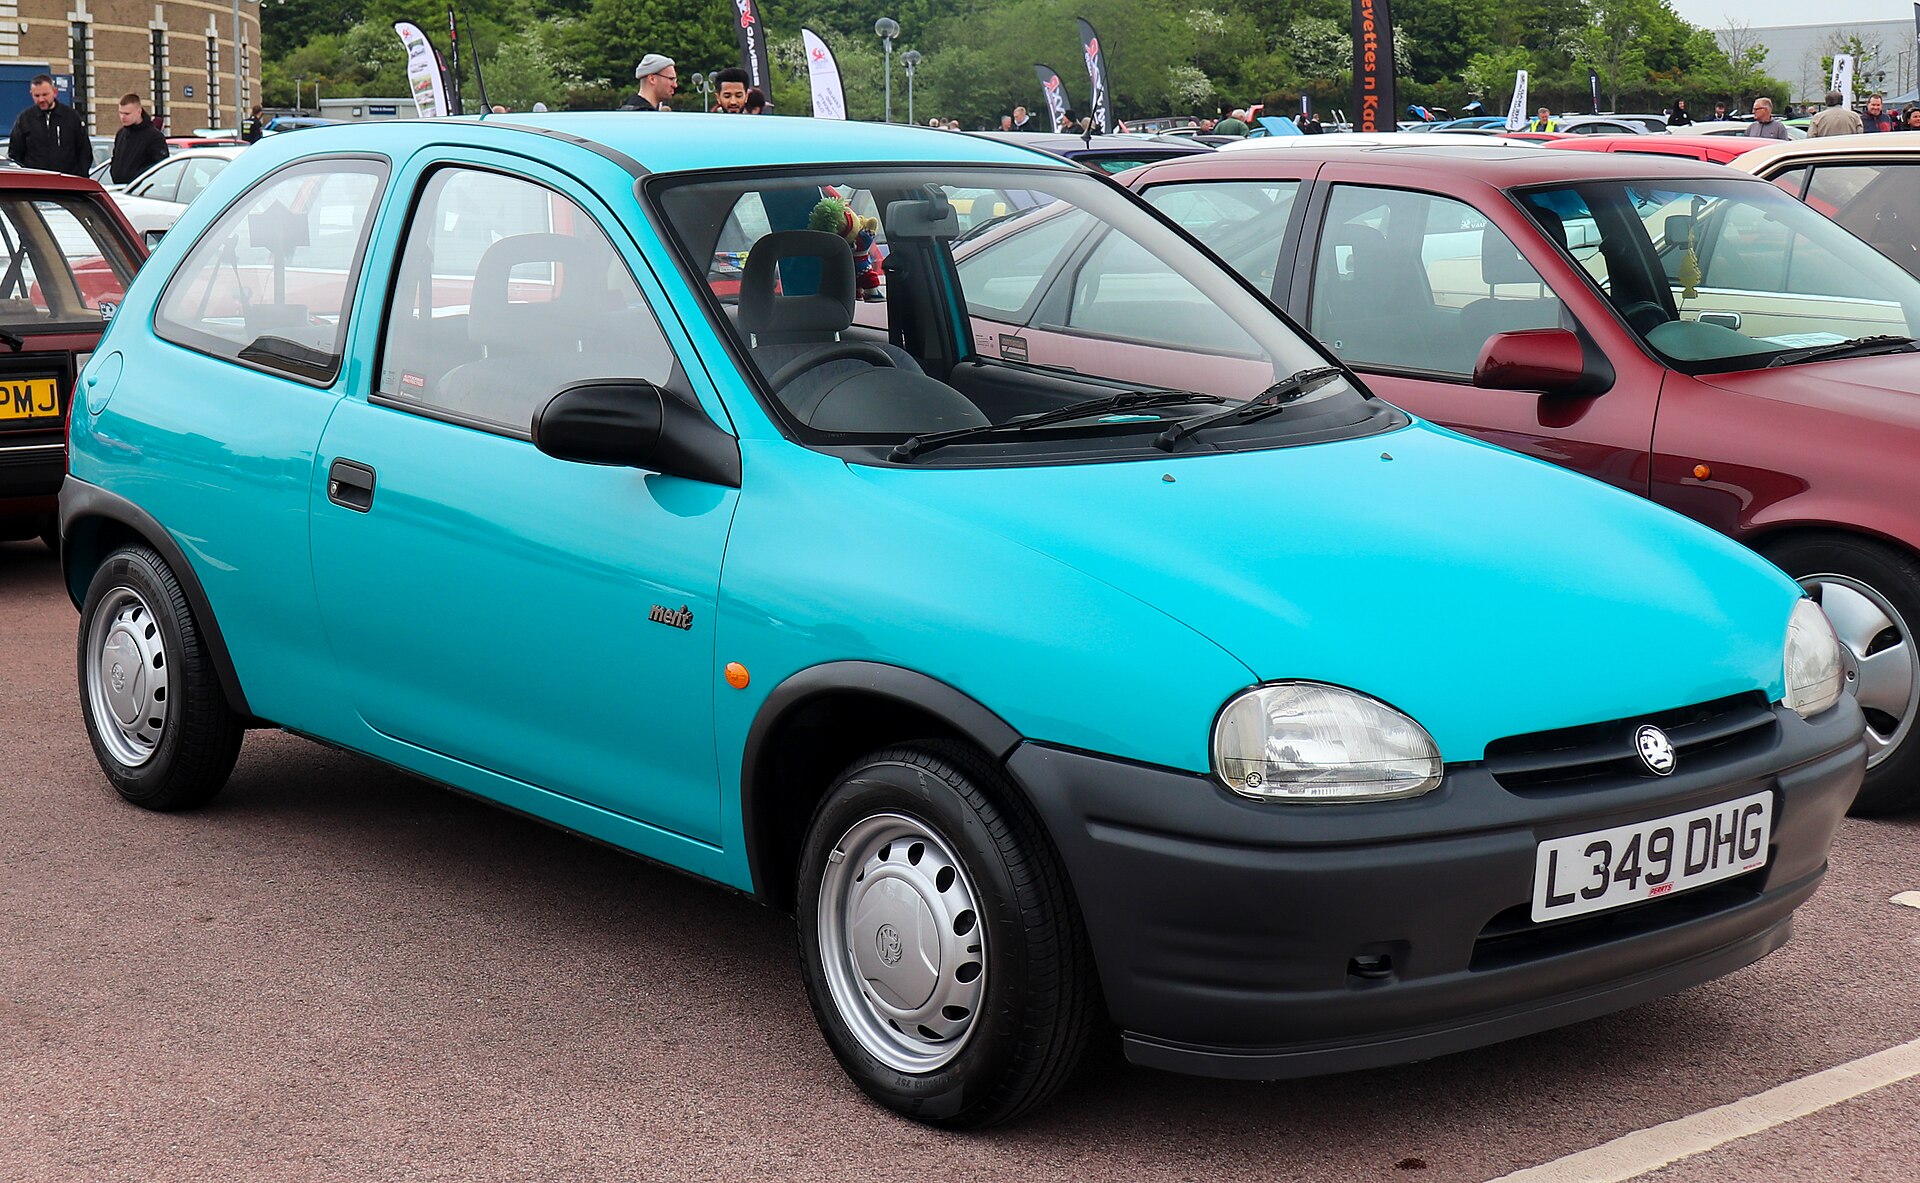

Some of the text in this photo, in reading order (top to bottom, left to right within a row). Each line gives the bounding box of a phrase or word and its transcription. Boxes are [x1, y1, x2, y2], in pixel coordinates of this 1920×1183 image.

[1364, 77, 1376, 90] n
[648, 604, 694, 631] merit
[1545, 803, 1763, 908] L349 DHG
